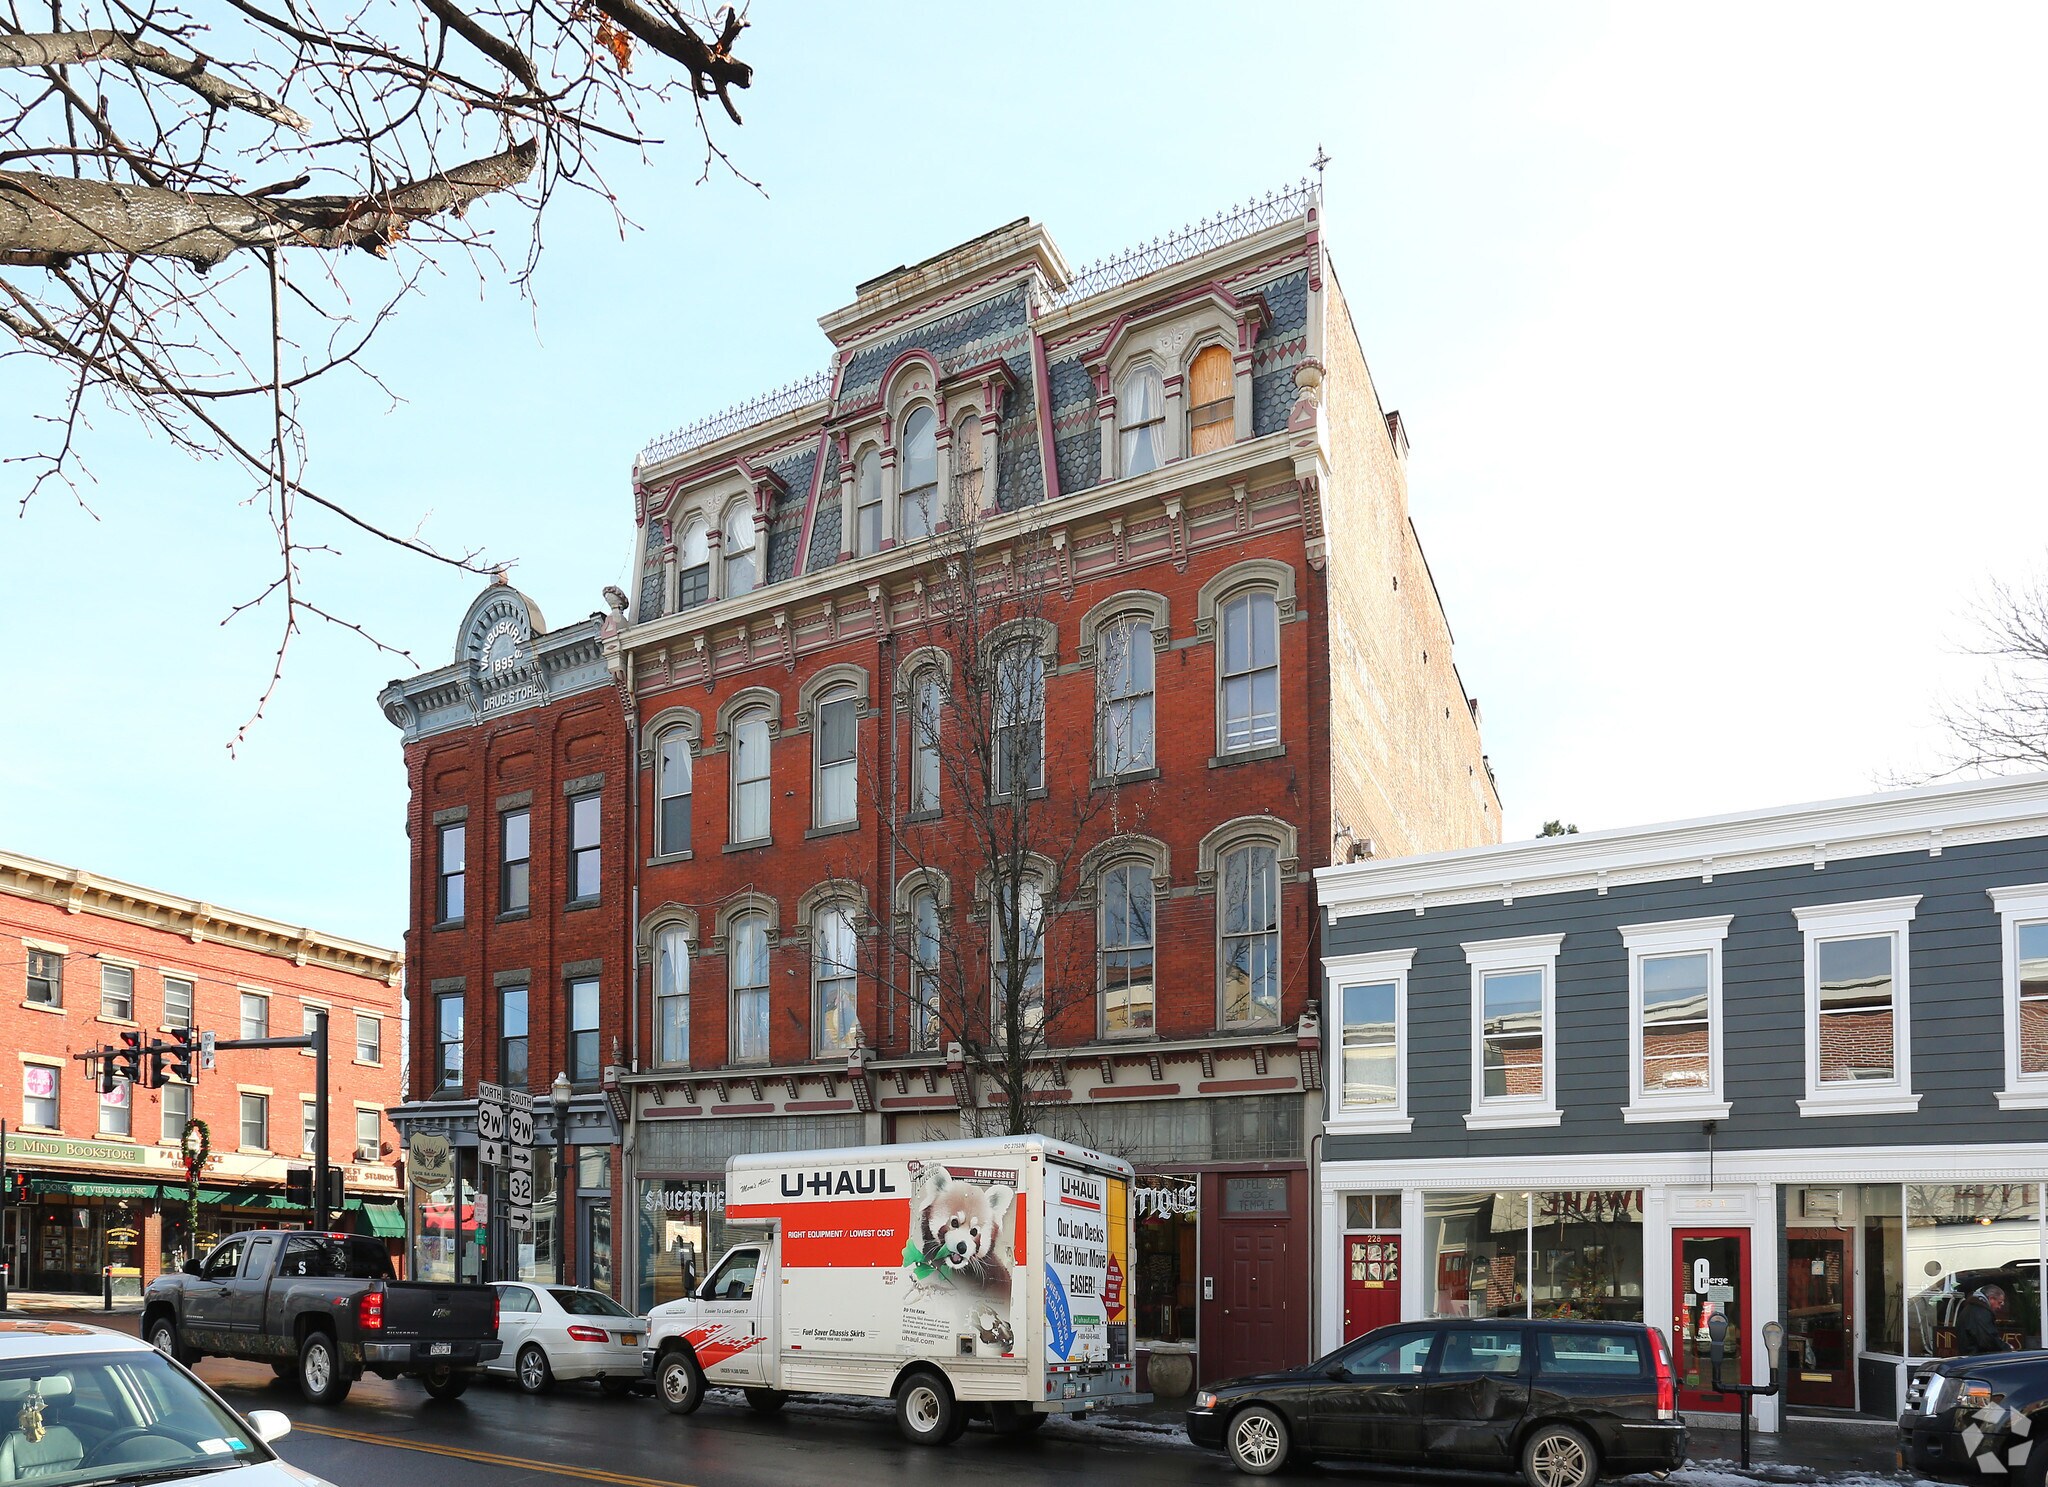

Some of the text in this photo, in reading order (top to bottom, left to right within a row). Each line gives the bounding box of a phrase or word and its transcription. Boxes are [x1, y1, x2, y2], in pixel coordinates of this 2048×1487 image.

[491, 655, 514, 673] 1895
[480, 1084, 502, 1101] NORTH
[511, 1093, 531, 1108] SOUTH
[481, 1109, 500, 1134] 9W
[512, 1117, 531, 1140] 9W
[23, 1140, 59, 1154] MIND
[66, 1143, 136, 1161] BOOKSTORE
[781, 1168, 896, 1197] U-HAUL
[973, 1169, 1015, 1179] TENNESSEE
[89, 1186, 115, 1194] VIDEO
[122, 1186, 147, 1195] MUSIC
[511, 1177, 531, 1199] 32
[1061, 1176, 1100, 1201] U-HAUL
[645, 1188, 725, 1212] SAUGERTIE
[1134, 1184, 1197, 1220] TIQUE
[1239, 1199, 1275, 1211] TEMPLE
[787, 1231, 806, 1239] RIGHT
[807, 1230, 843, 1238] EQUIPMENT
[849, 1229, 875, 1237] LOWEST
[877, 1229, 894, 1237] COST
[1057, 1217, 1104, 1243] Our Low Decks
[1053, 1244, 1106, 1269] Make Your Move
[298, 1261, 307, 1275] S
[1046, 1277, 1061, 1304] OWEST
[1070, 1274, 1096, 1295] EASIER!
[829, 1329, 849, 1337] Chassis
[849, 1330, 866, 1338] Skirts
[901, 1335, 935, 1345] uhaul.com
